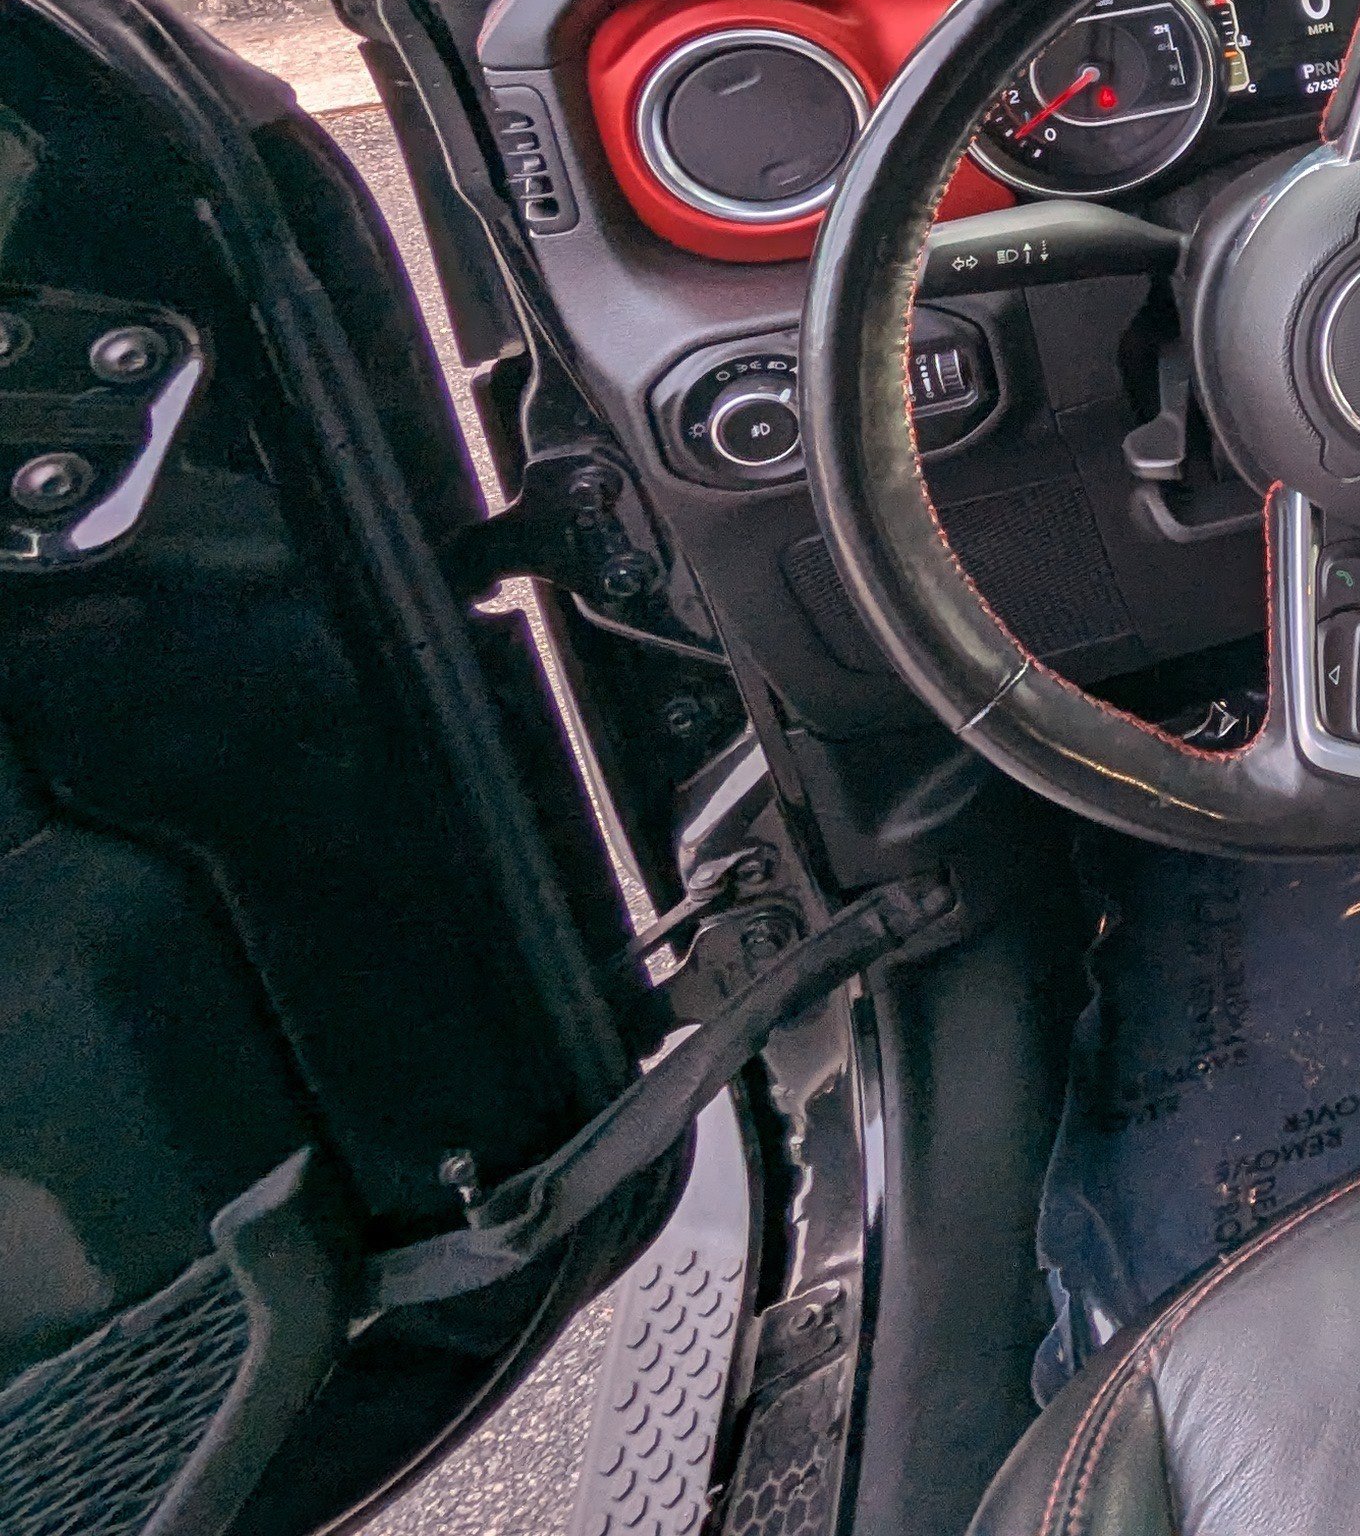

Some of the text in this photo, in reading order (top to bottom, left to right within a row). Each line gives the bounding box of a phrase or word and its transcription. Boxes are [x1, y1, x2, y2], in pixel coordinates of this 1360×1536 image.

[1307, 22, 1334, 36] MPH
[1248, 84, 1257, 93] C
[1009, 90, 1020, 104] 2
[1044, 128, 1057, 142] 0
